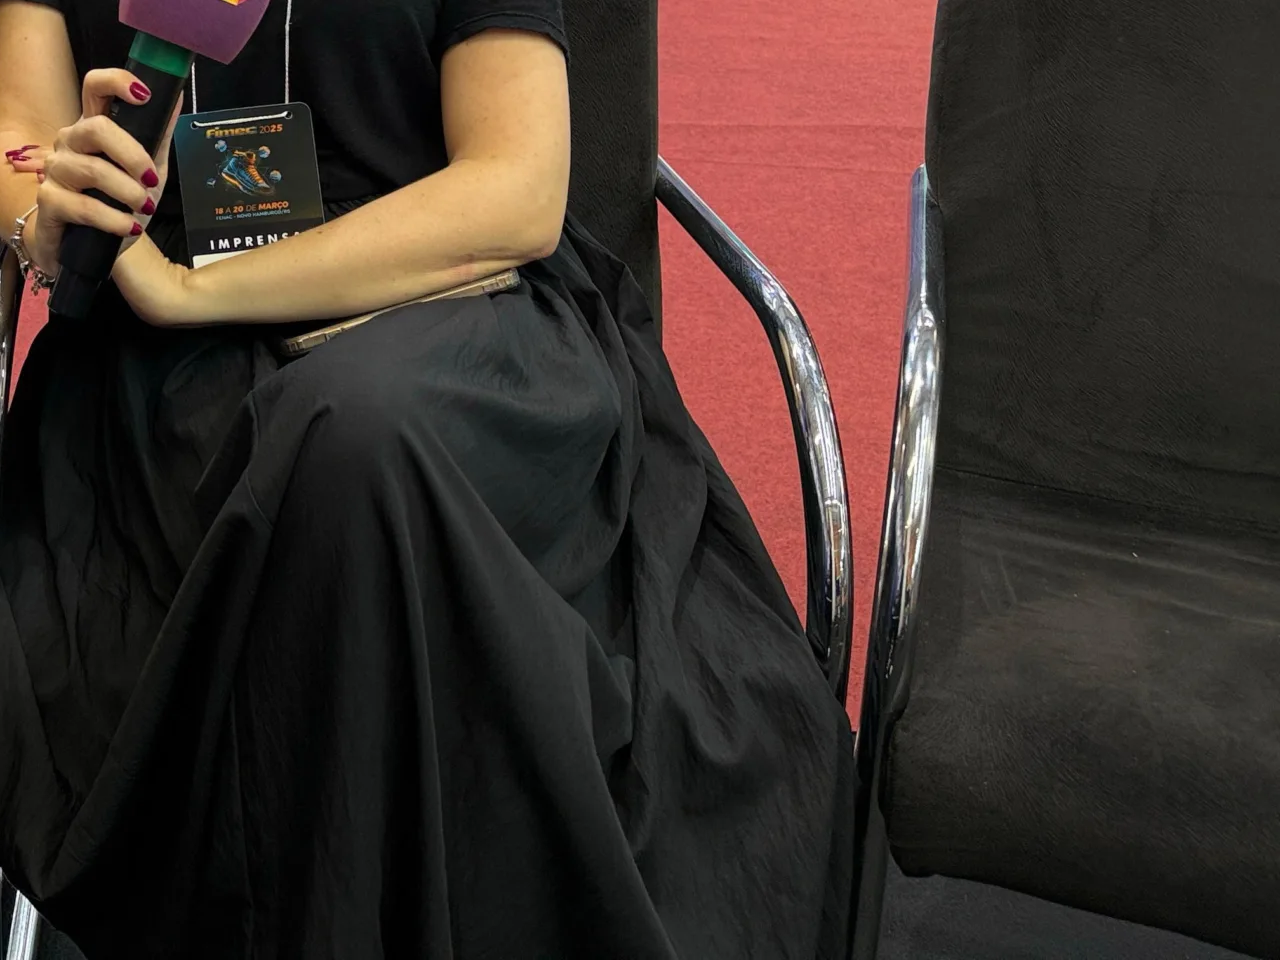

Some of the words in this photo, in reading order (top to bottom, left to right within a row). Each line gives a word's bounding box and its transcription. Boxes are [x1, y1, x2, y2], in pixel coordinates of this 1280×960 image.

[260, 124, 283, 134] 2025
[215, 207, 224, 215] 18
[233, 205, 244, 214] 20
[246, 204, 257, 212] DE
[258, 200, 289, 211] MARÇO
